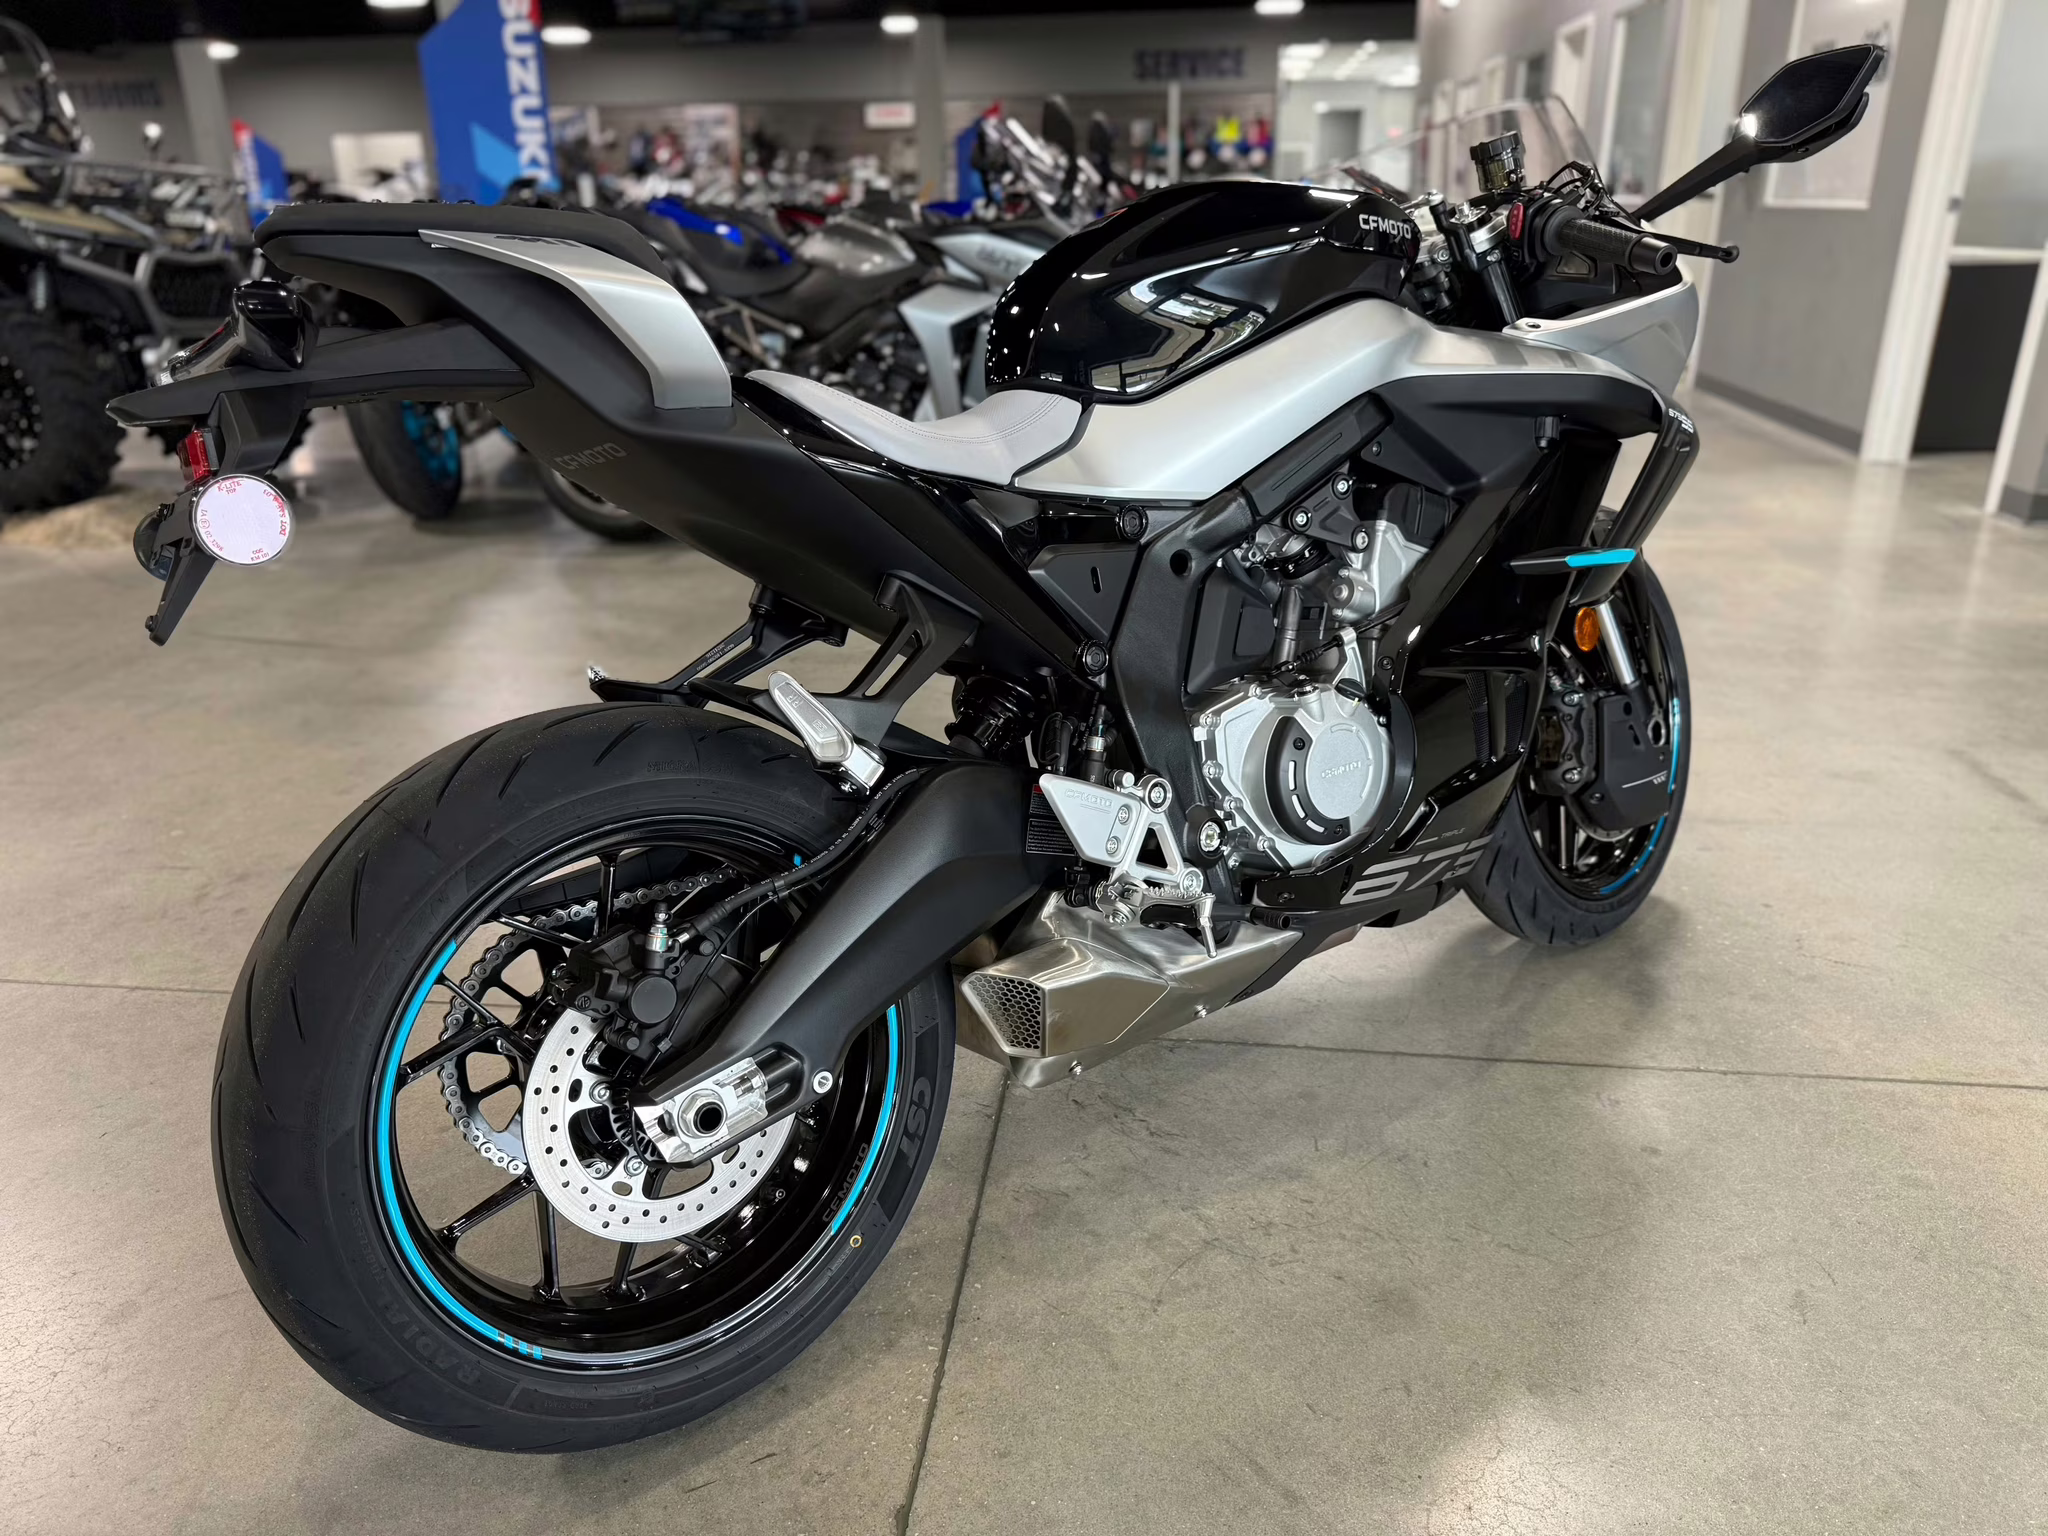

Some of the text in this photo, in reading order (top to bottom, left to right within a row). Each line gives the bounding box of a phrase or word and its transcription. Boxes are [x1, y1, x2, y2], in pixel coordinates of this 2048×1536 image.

[1358, 213, 1412, 240] CFMOTO
[553, 442, 627, 470] CFMOTO
[899, 1076, 932, 1169] CST
[822, 1142, 869, 1222] CFMOTO
